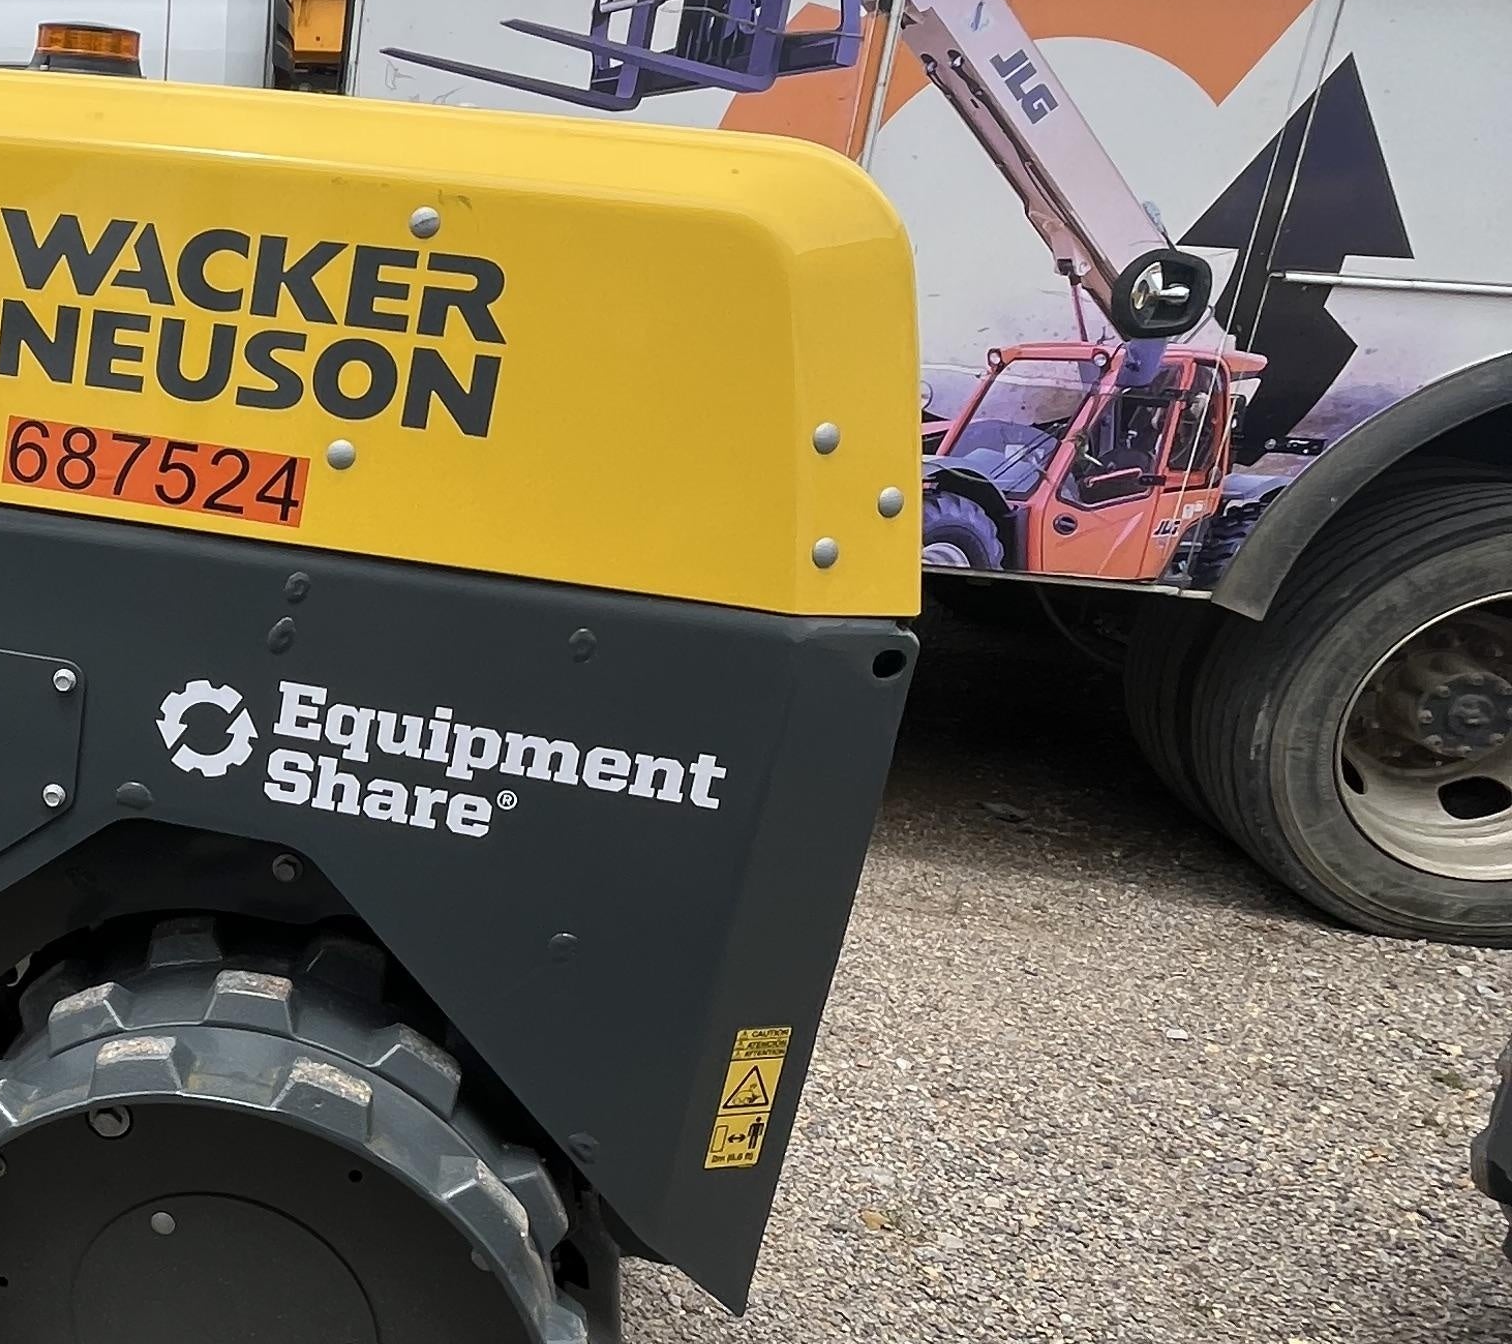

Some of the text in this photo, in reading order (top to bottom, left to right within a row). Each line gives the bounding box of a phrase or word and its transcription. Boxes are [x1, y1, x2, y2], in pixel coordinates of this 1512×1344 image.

[989, 49, 1059, 125] JLG
[0, 207, 506, 345] WACKER
[8, 418, 300, 523] 687524
[273, 680, 727, 810] Equipment
